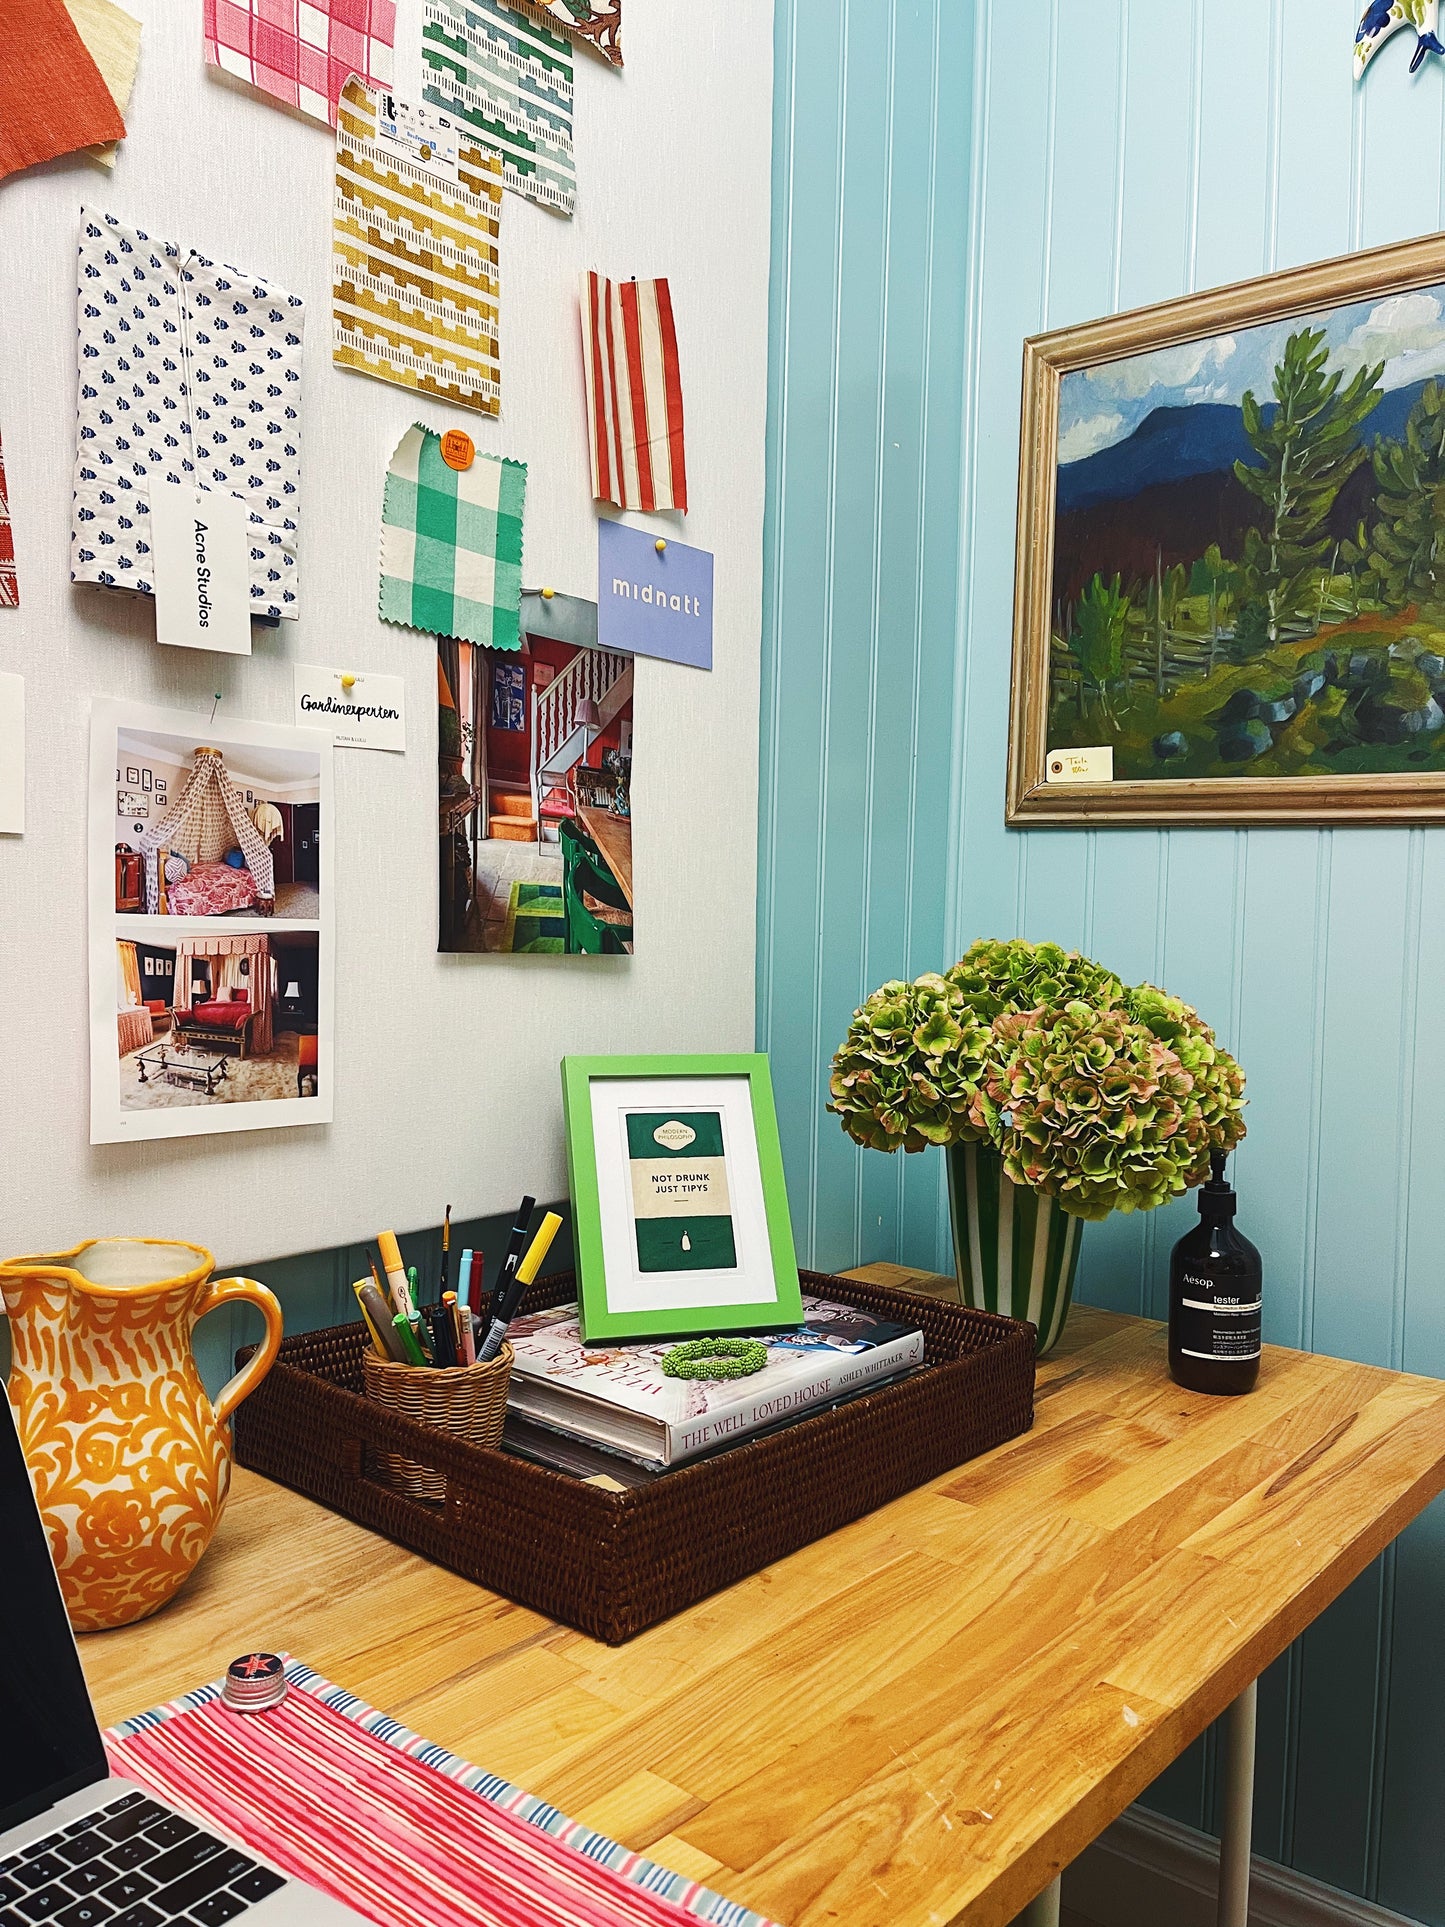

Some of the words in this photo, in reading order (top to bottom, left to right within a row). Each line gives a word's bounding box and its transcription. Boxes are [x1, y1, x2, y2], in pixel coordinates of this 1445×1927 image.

[194, 519, 209, 564] Acne
[197, 567, 213, 628] Studios
[612, 578, 700, 617] midnatt
[301, 694, 399, 722] Gardinexperten
[651, 1174, 672, 1183] NOT
[675, 1173, 710, 1182] DRUNK
[655, 1185, 678, 1194] JUST
[681, 1184, 708, 1193] TIPYS
[1213, 1295, 1240, 1305] tester
[596, 1370, 664, 1395] WELL
[839, 1368, 864, 1386] ASHLEY
[864, 1353, 904, 1374] WHITTAKER
[681, 1425, 711, 1450] THE
[713, 1412, 747, 1437] WELL
[753, 1394, 792, 1422] LOVED
[794, 1378, 832, 1405] HOUSE
